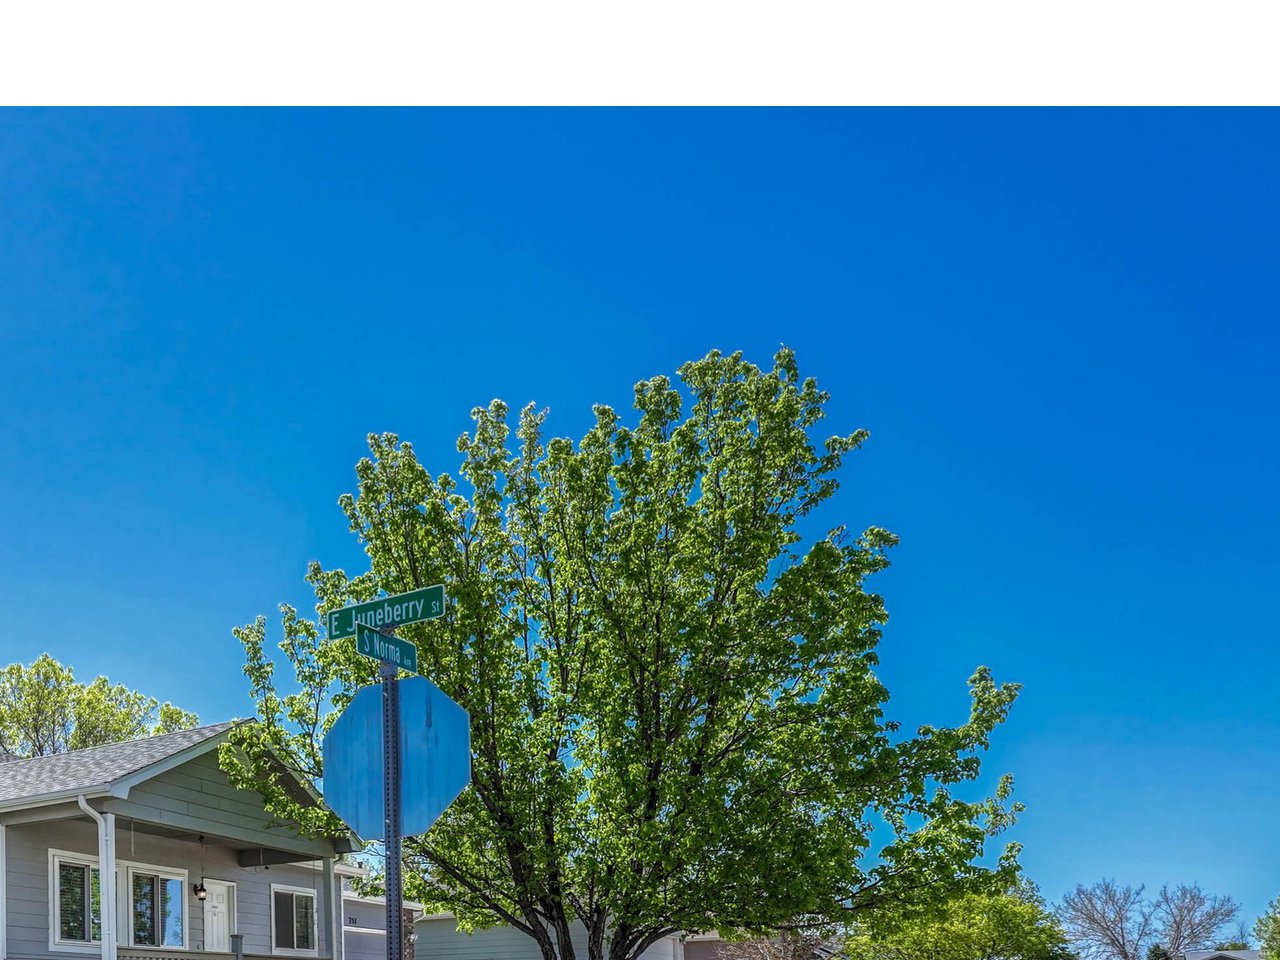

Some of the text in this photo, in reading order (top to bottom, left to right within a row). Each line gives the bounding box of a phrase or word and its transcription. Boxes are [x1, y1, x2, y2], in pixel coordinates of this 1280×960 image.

[331, 599, 440, 636] E Juneberry St
[364, 629, 370, 652] S
[373, 633, 400, 664] Norma
